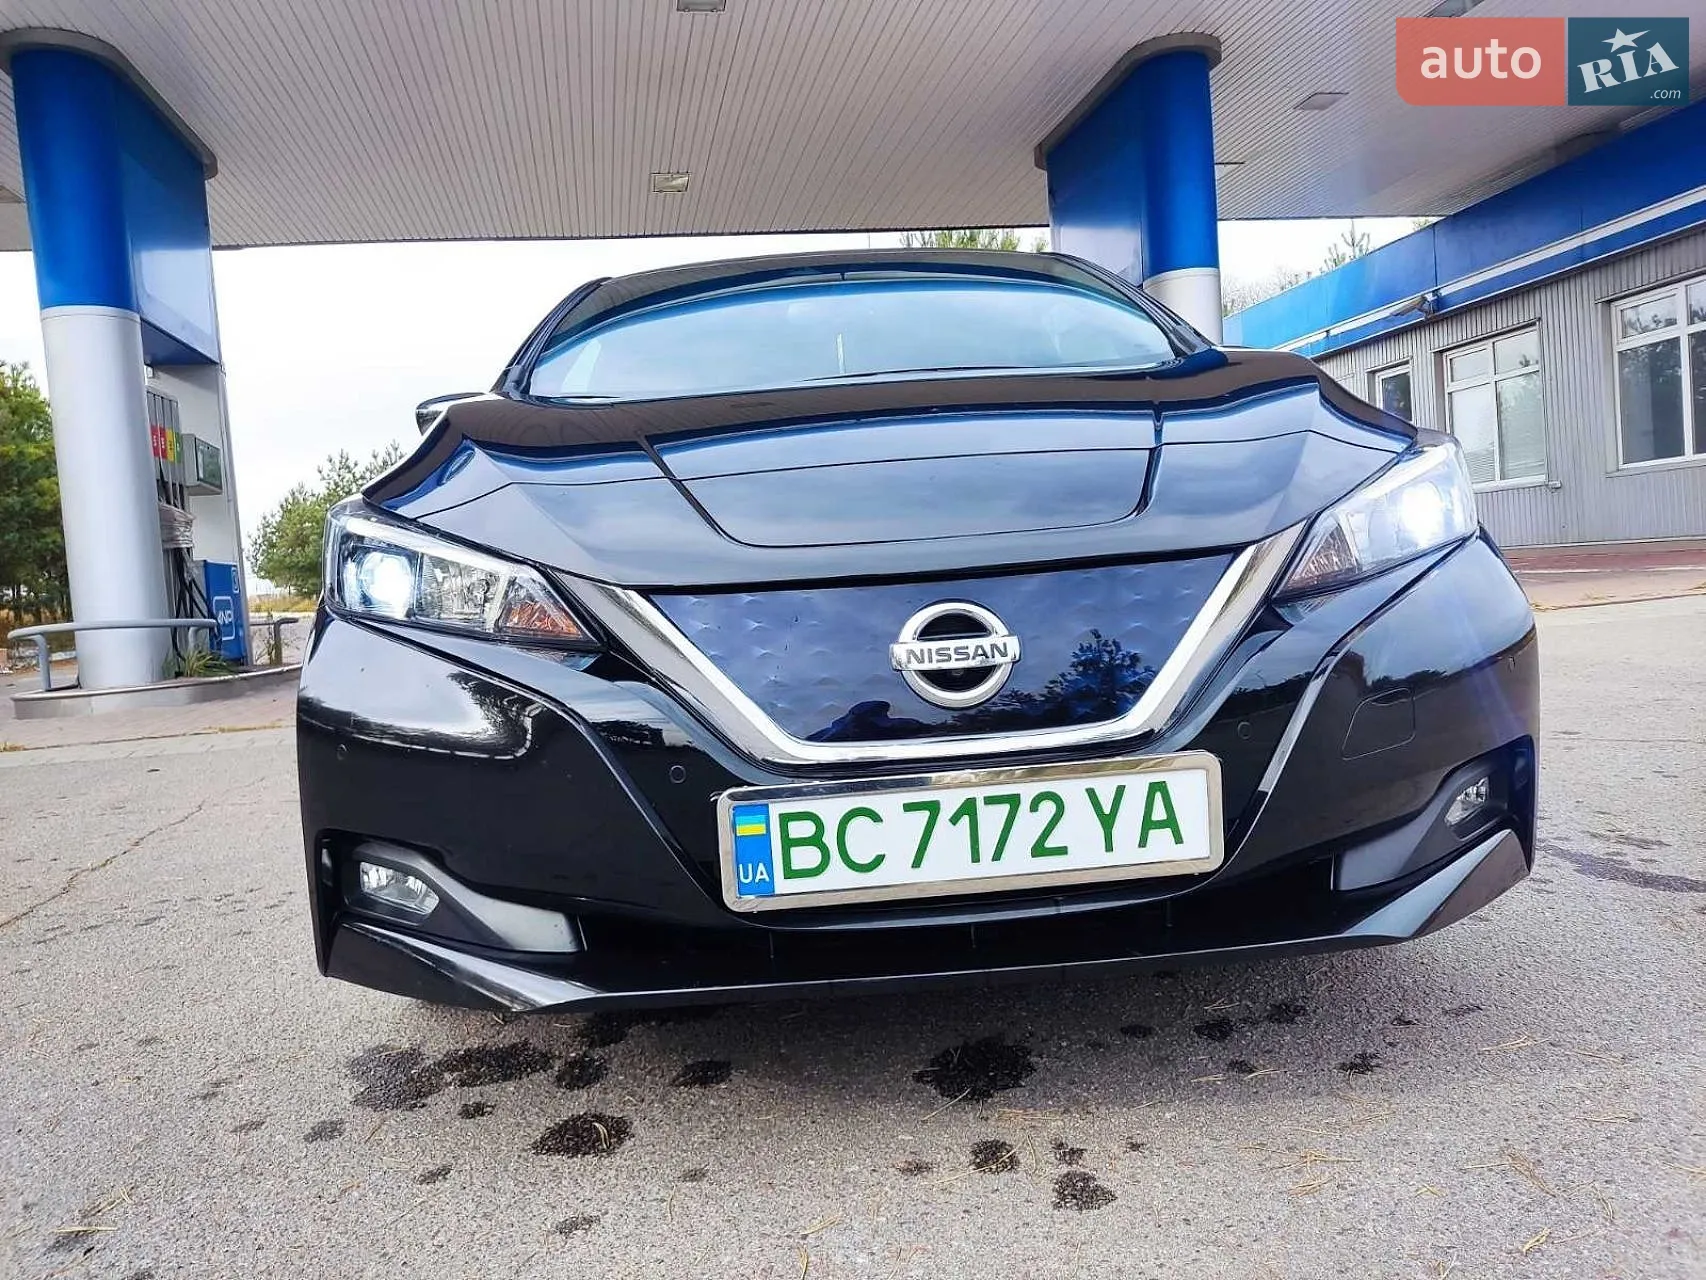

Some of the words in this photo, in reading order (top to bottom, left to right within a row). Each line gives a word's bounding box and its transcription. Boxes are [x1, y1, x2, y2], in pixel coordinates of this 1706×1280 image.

[906, 642, 1008, 665] NISSAN
[778, 806, 886, 880] BC
[903, 790, 1068, 869] 7172
[1085, 780, 1184, 853] YA
[738, 861, 770, 885] UA
